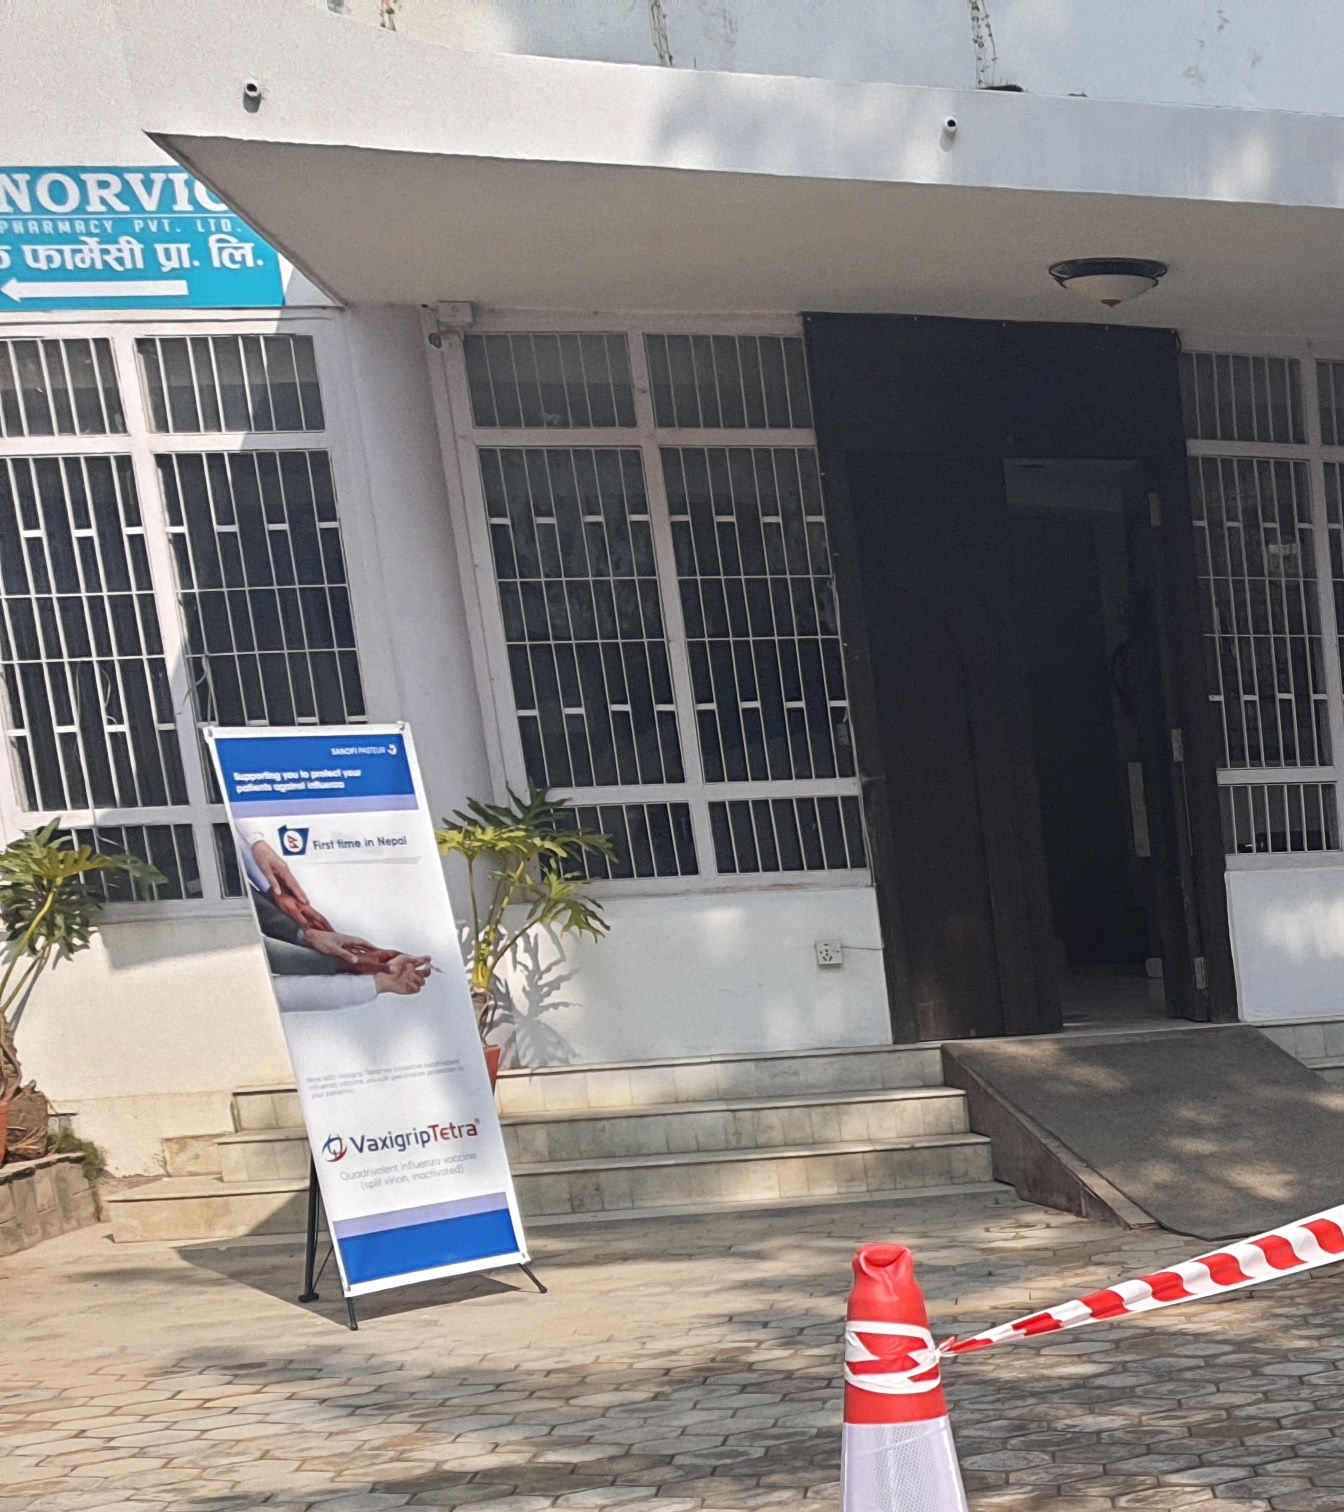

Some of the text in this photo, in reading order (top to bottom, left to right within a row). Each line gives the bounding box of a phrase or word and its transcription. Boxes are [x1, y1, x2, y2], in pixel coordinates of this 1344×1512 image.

[0, 173, 230, 213] NORVIC
[0, 218, 242, 234] PHARMACY PVT. LTD.
[154, 243, 200, 272] प्रा.
[208, 234, 264, 269] लि.
[313, 836, 407, 850] First time in Nepal
[340, 1151, 477, 1181] Quadrivalent influenza vaccine
